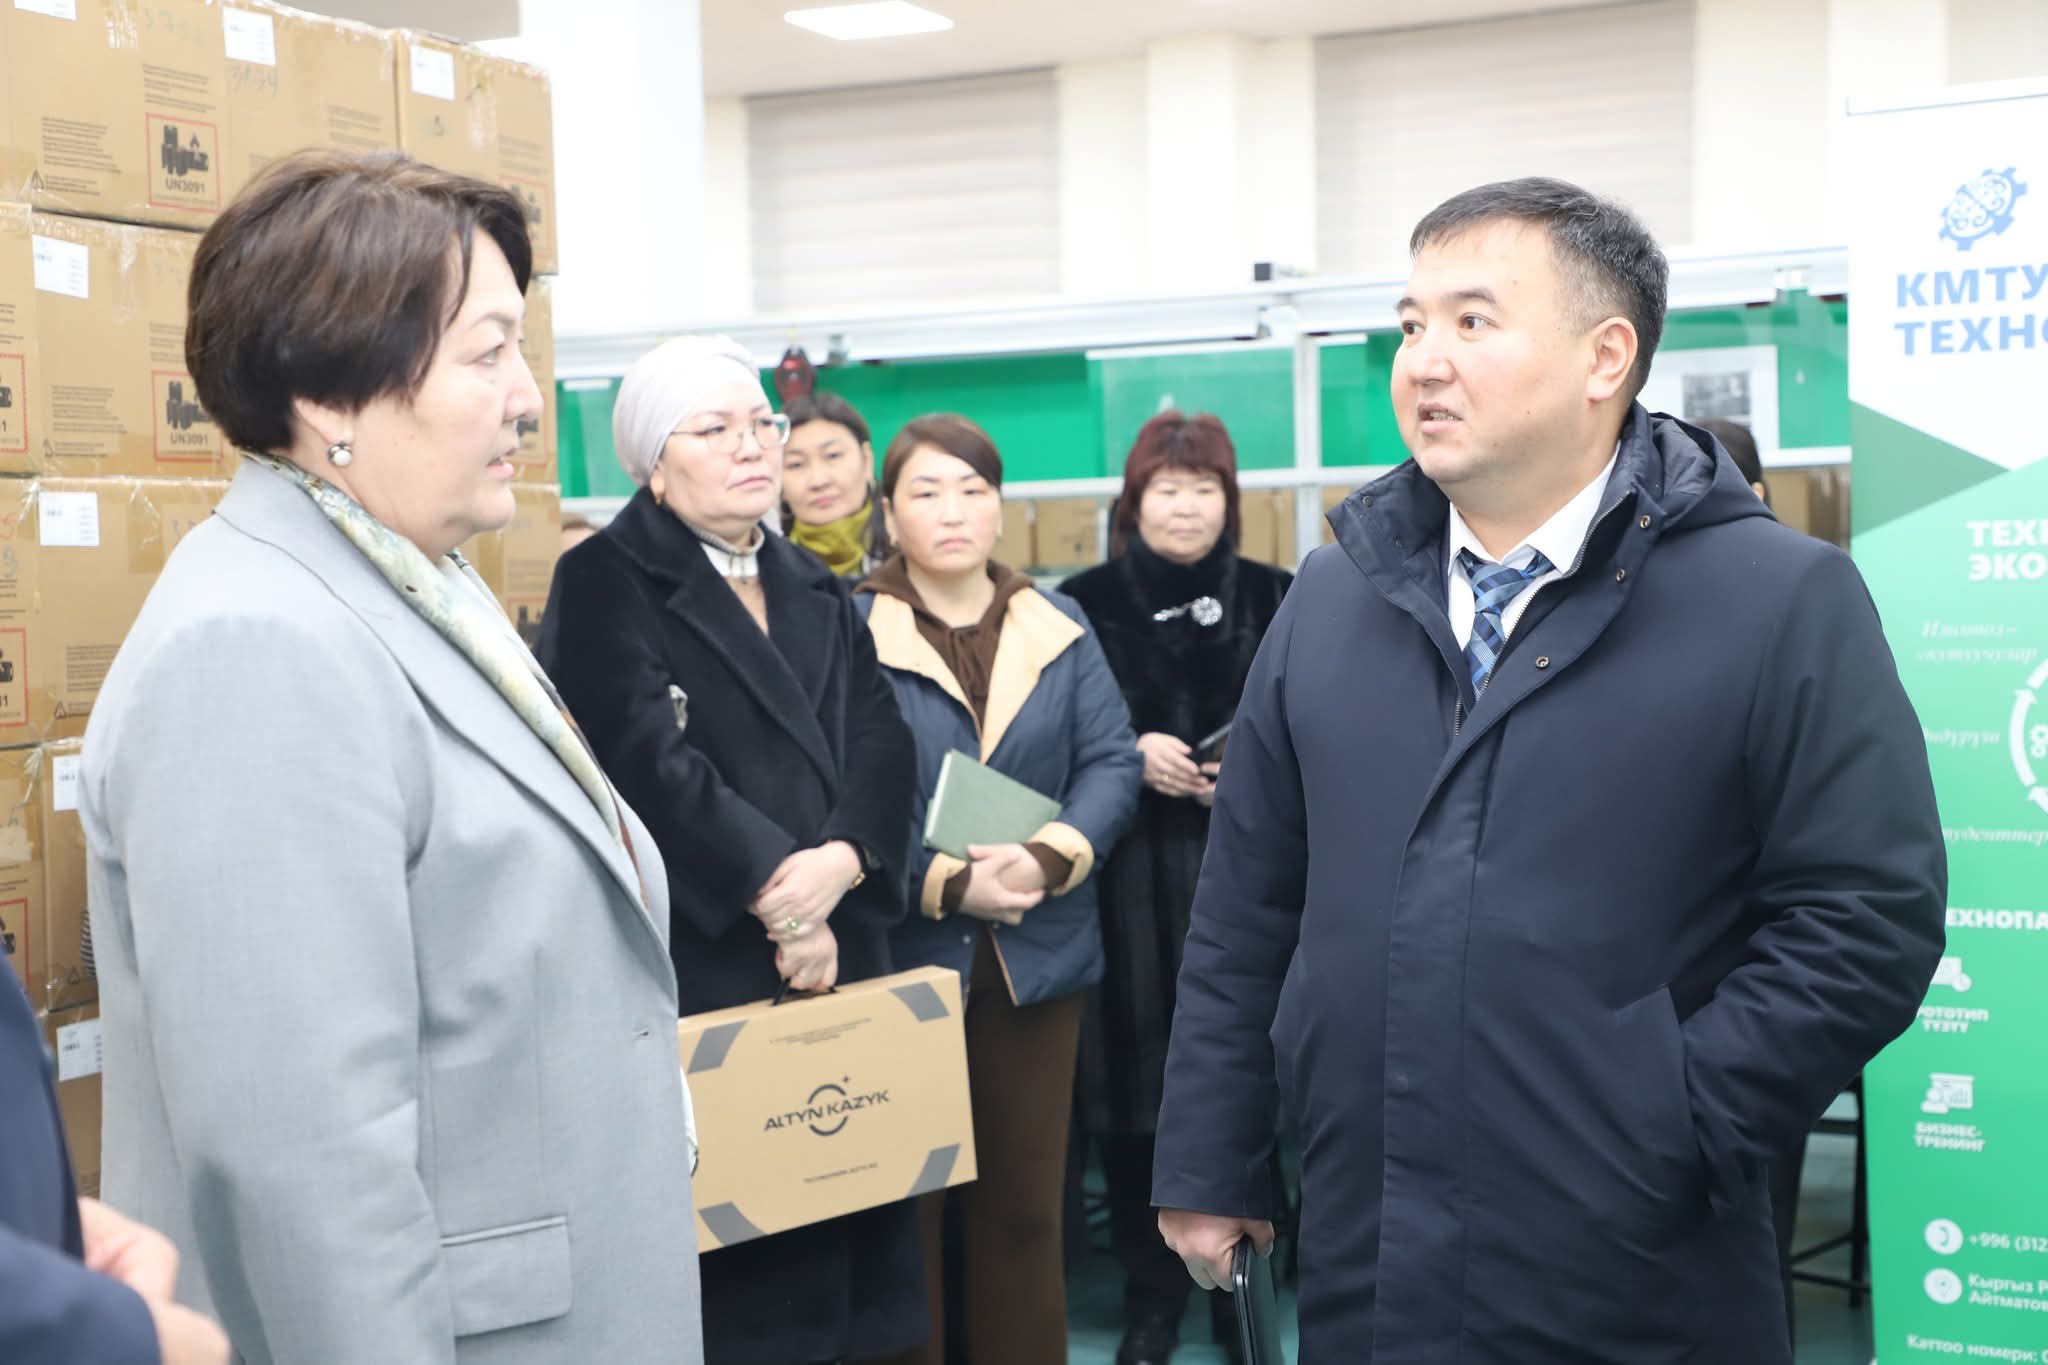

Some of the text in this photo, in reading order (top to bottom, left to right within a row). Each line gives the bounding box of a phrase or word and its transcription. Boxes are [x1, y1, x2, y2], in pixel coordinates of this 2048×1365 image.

[1896, 264, 2048, 308] КМТУ
[1894, 314, 2048, 356] ТЕХН
[1945, 908, 2048, 930] ЕХНОПА
[763, 1090, 890, 1131] ALTYN KAZYK
[1969, 1232, 2011, 1249] +996
[1968, 1273, 2033, 1293] Кыргыз
[1906, 1333, 1964, 1354] Каттоо
[1966, 1343, 2038, 1363] номери:
